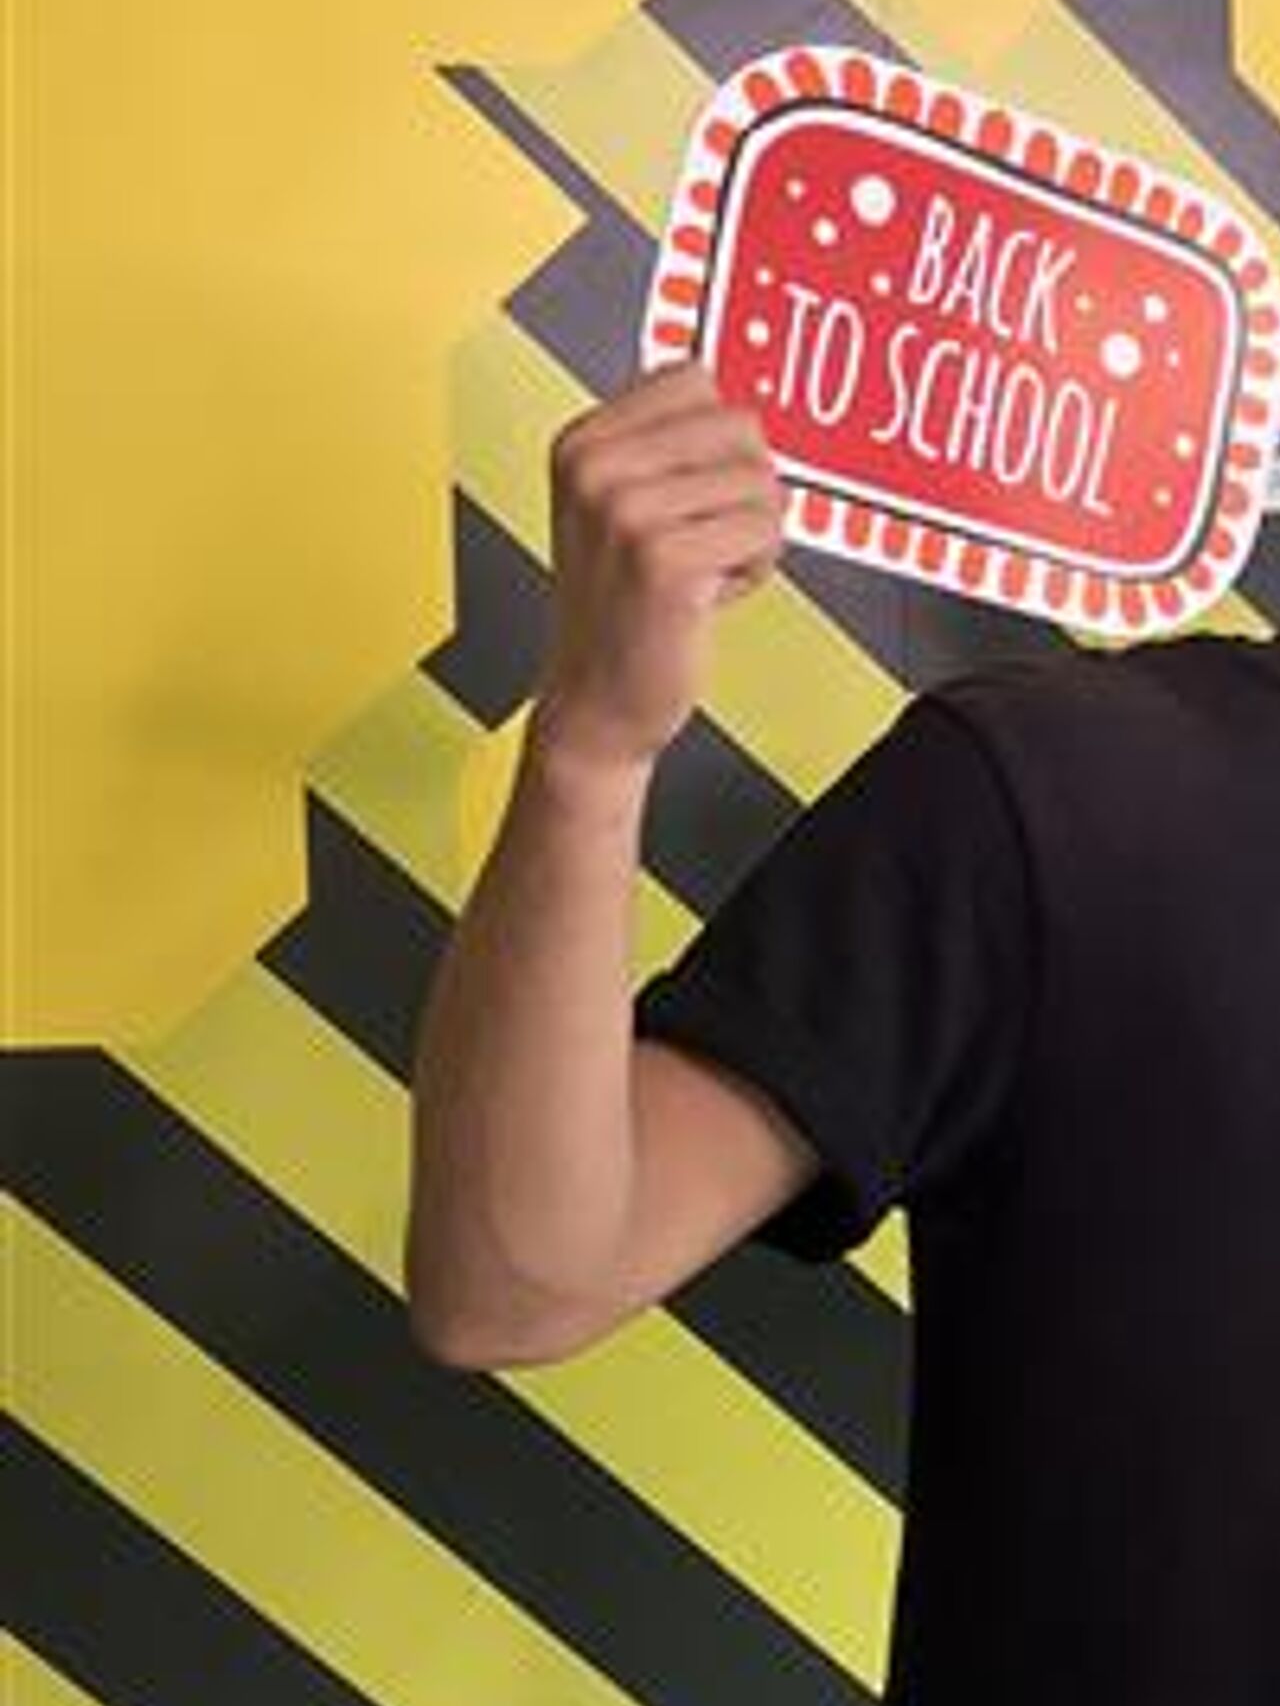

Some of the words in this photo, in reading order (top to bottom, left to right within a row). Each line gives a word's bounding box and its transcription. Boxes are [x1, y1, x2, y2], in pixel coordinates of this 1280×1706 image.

[908, 194, 1078, 355] BACK
[778, 281, 864, 427] TO
[869, 324, 1121, 517] SCHOOL
